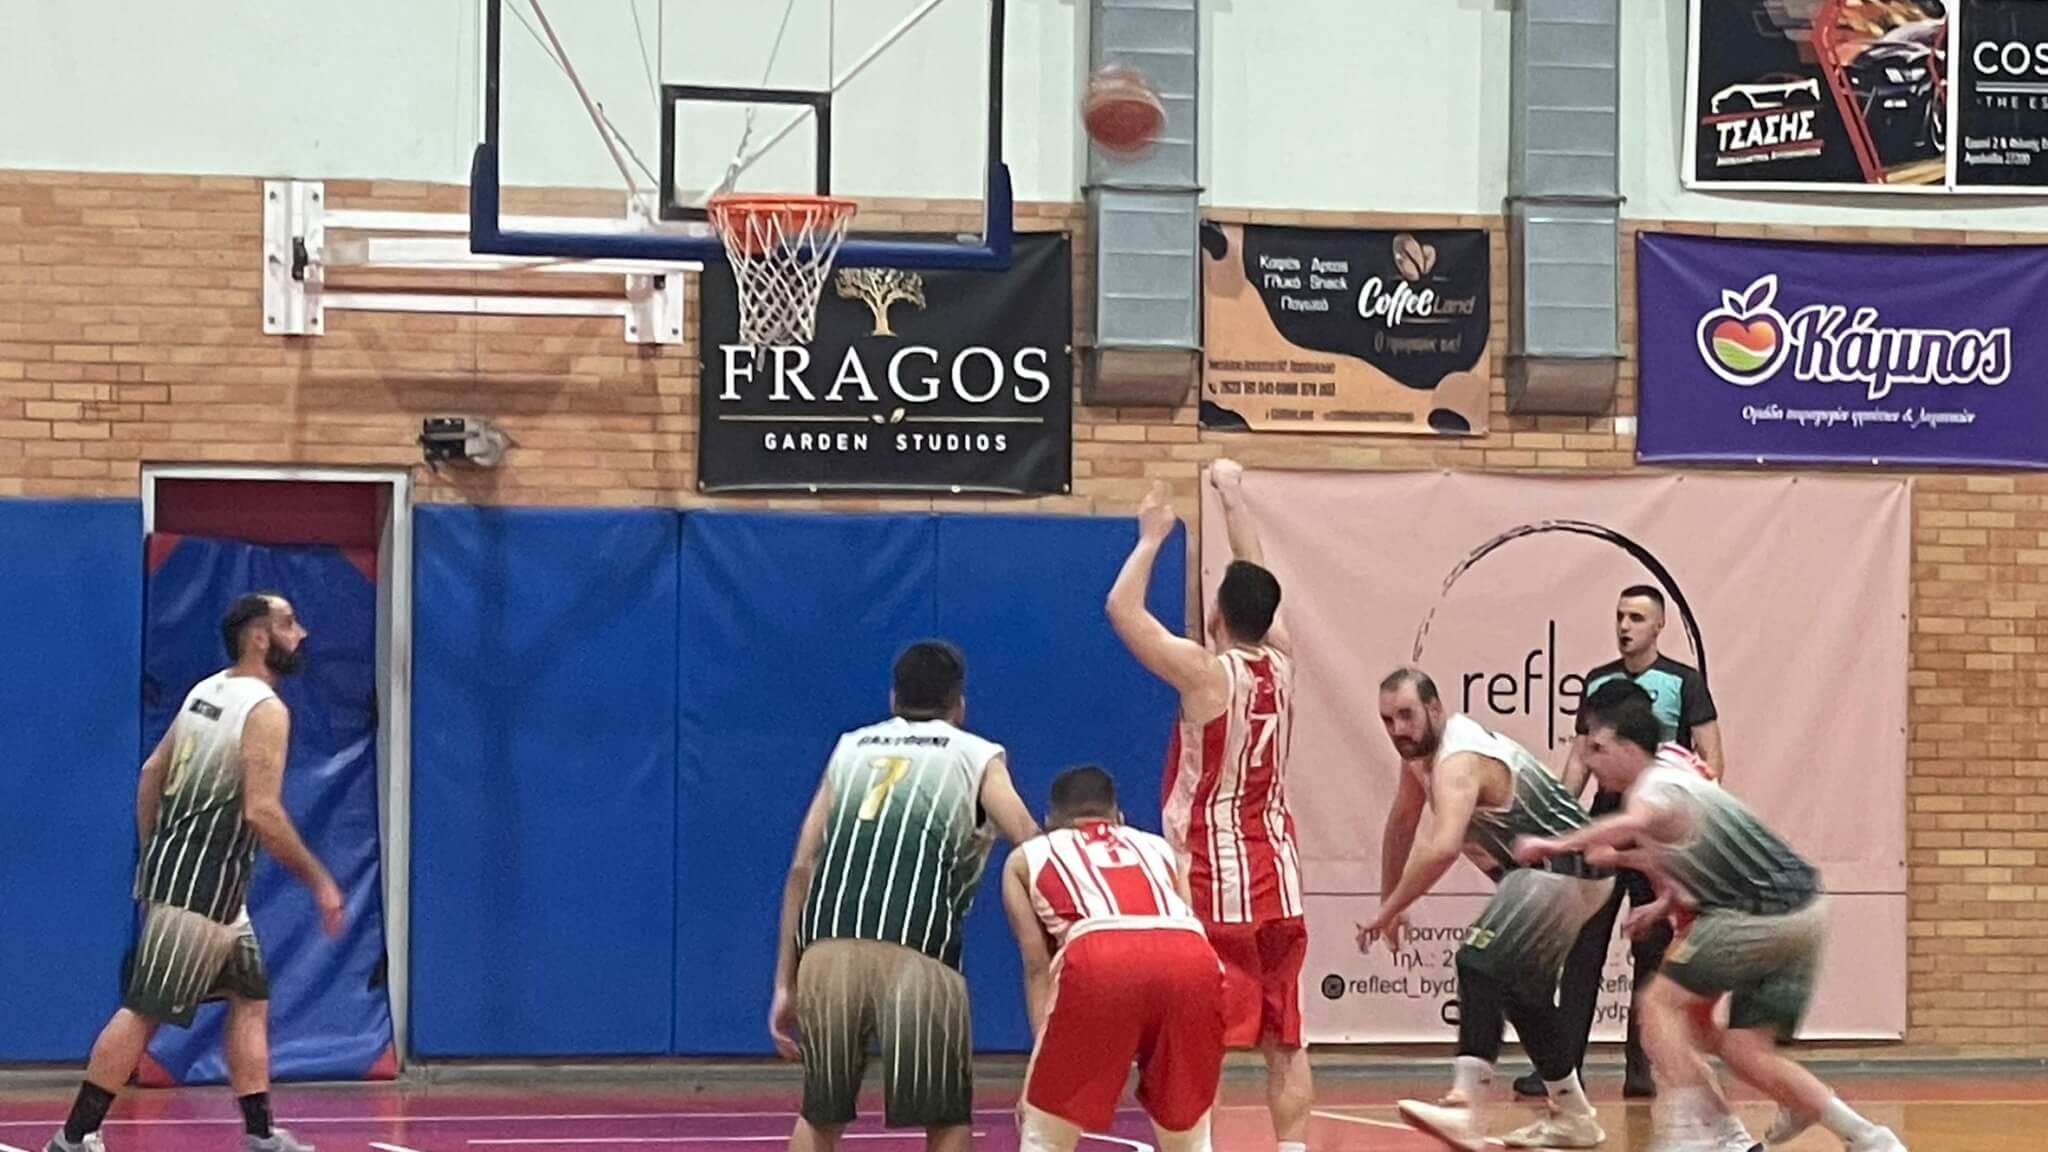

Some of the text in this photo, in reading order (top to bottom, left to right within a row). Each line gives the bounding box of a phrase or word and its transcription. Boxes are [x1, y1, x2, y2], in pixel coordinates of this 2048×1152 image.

[1973, 41, 2048, 75] COS
[1986, 95, 2018, 109] THE
[1716, 110, 1815, 151] ΤΣΑΣΗΣ
[719, 345, 1051, 403] FRAGOS
[1789, 305, 2011, 400] Κάμπος
[765, 432, 1007, 451] GARDEN STUDIOS
[1463, 620, 1586, 750] refle
[1249, 713, 1278, 768] 7
[859, 756, 912, 820] 7
[1350, 975, 1456, 998] reflect_byd
